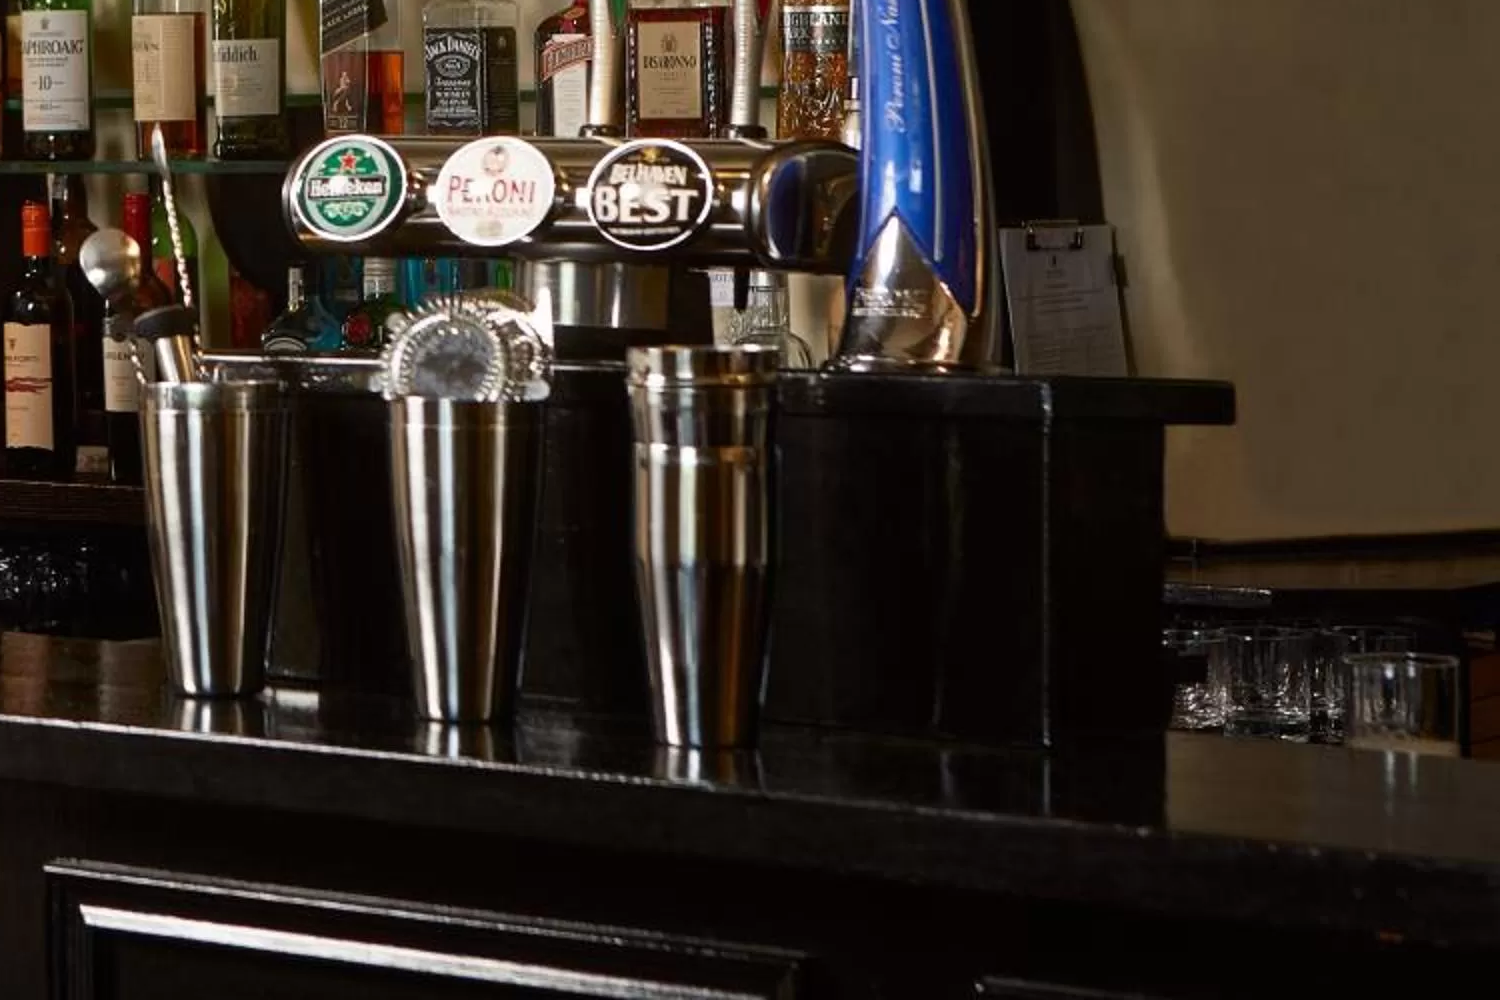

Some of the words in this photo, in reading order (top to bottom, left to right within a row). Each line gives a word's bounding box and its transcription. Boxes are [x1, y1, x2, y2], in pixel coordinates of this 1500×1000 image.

[426, 41, 447, 63] JACK
[643, 54, 698, 69] DISARONNO
[38, 75, 52, 90] 10
[884, 51, 906, 134] Peroni
[609, 162, 688, 186] BELHAVEN
[447, 174, 537, 204] PEONI
[594, 182, 699, 223] BEST
